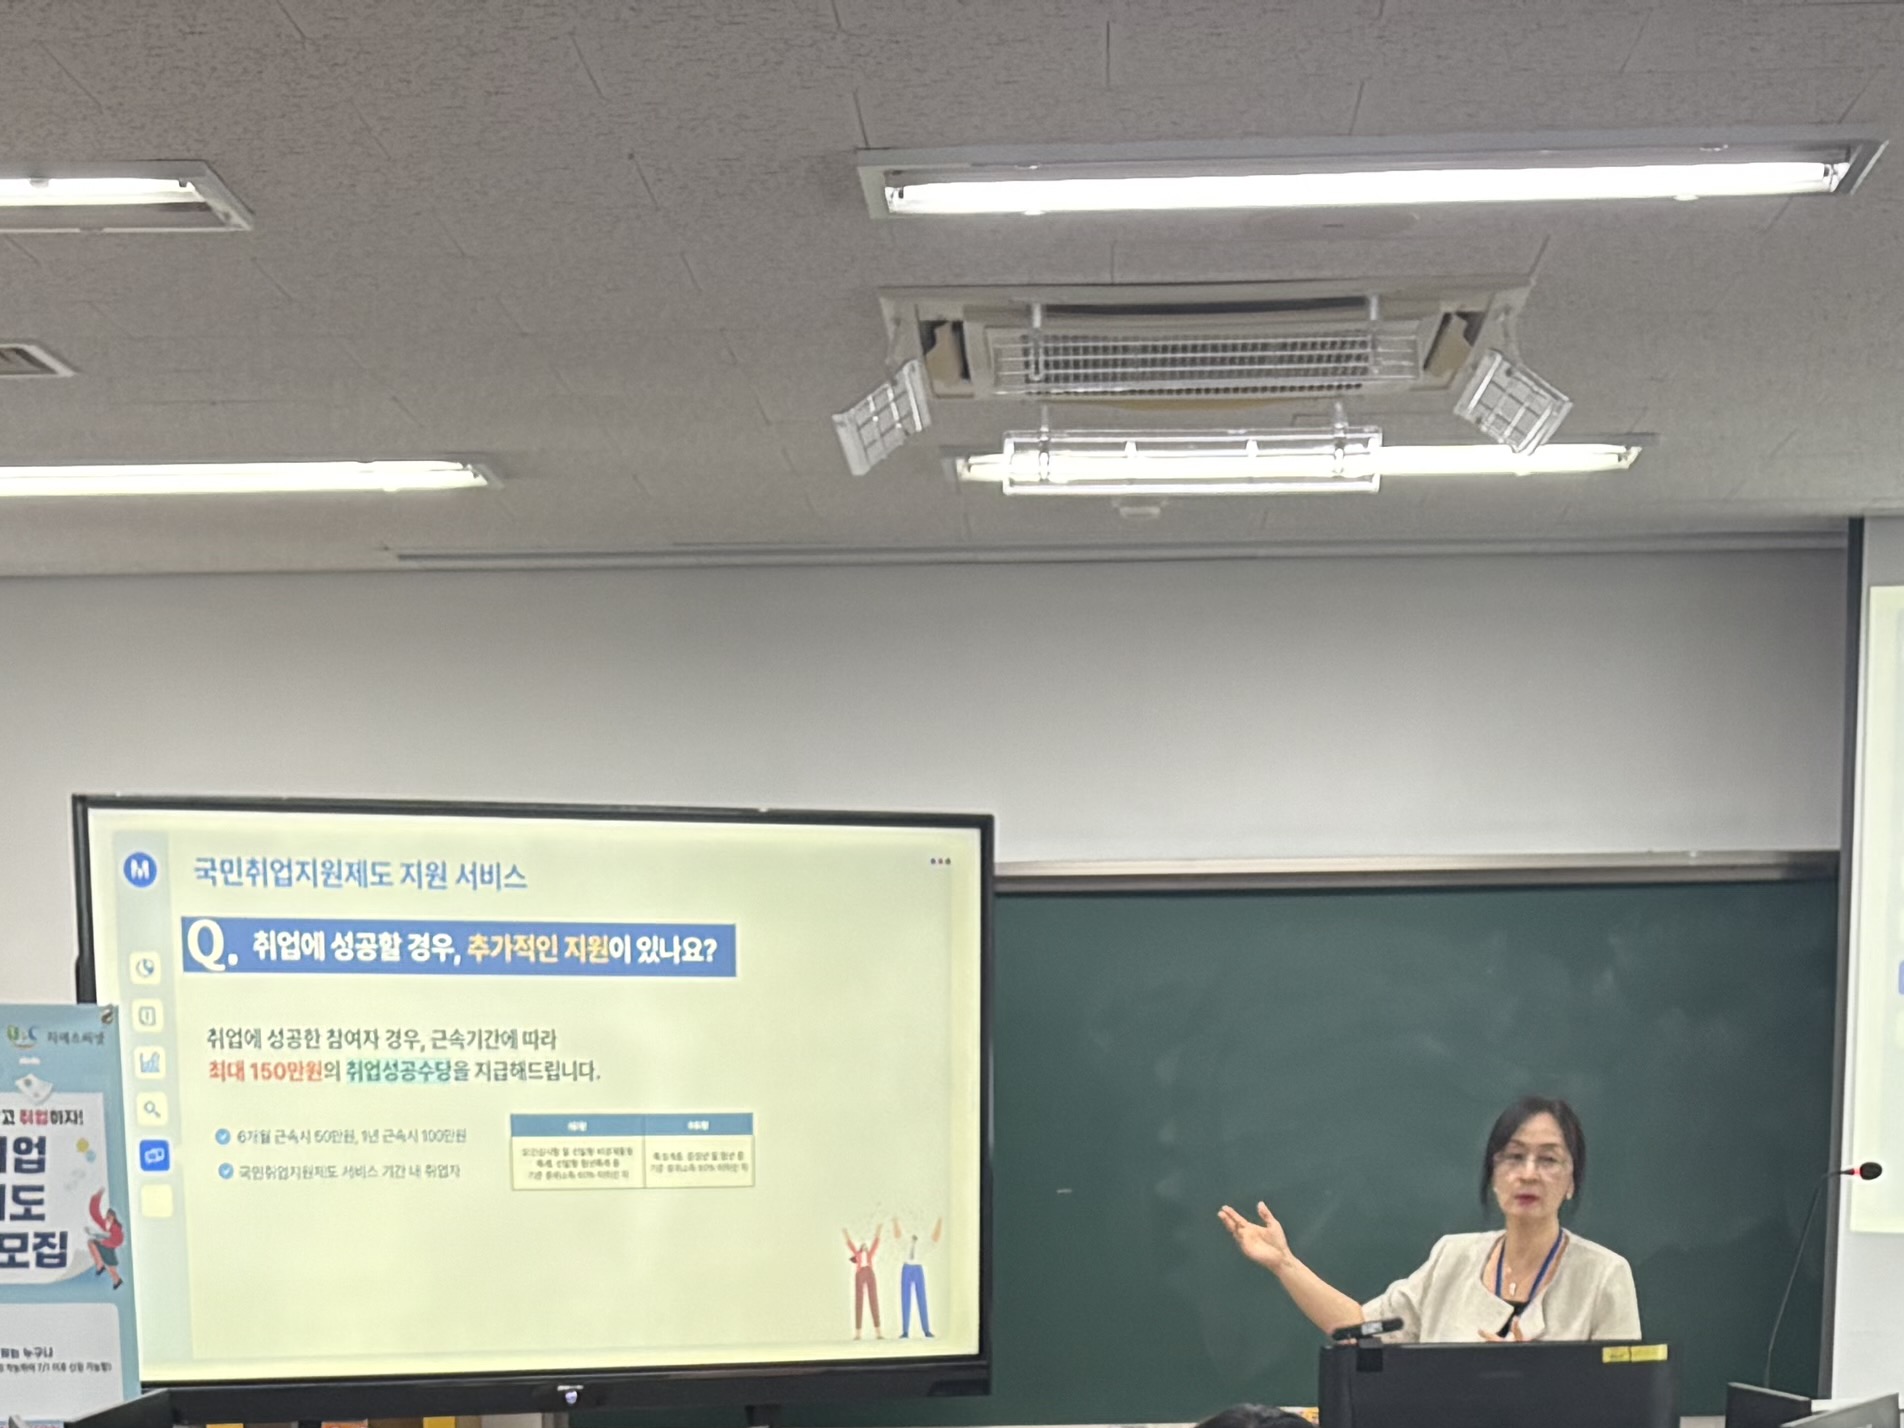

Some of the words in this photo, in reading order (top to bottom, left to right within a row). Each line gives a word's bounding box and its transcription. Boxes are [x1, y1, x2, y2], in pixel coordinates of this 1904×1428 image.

[194, 856, 394, 888] 국민취업지원제도
[400, 859, 448, 890] 지원
[455, 861, 528, 891] 서비스
[187, 918, 239, 972] Q.
[252, 930, 325, 962] 취업에
[331, 931, 402, 963] 성공할
[407, 932, 461, 966] 경우,
[467, 933, 559, 964] 추가적인
[564, 934, 632, 965] 지원이
[636, 934, 718, 965] 있나요?
[207, 1028, 262, 1050] 취업에
[267, 1028, 321, 1050] 성공한
[326, 1028, 379, 1050] 참여자
[385, 1029, 426, 1053] 경우,
[430, 1028, 518, 1050] 근속기간에
[522, 1028, 558, 1051] 따라
[208, 1059, 245, 1082] 최대
[250, 1059, 341, 1083] 150만원의
[346, 1059, 470, 1083] 취업성공수당을
[474, 1059, 601, 1083] 지급해드립니다.
